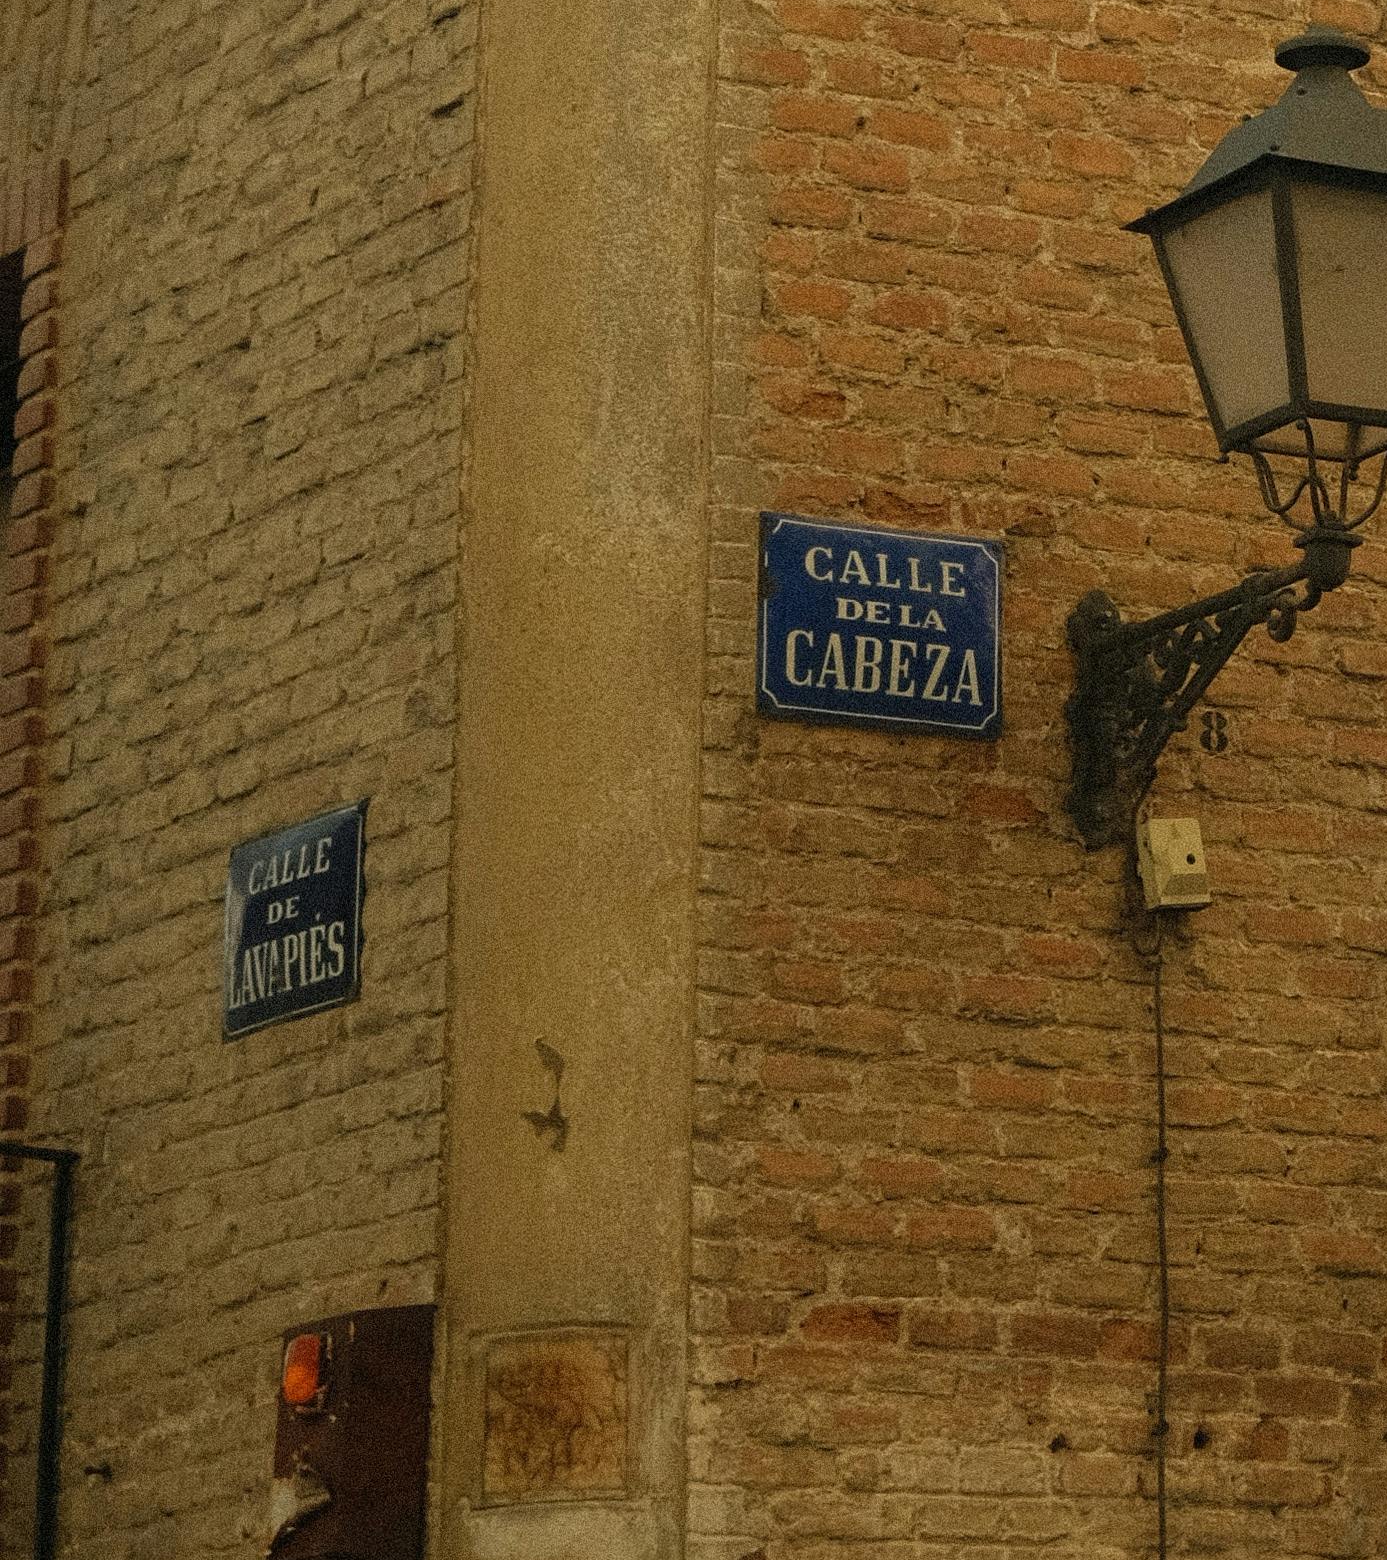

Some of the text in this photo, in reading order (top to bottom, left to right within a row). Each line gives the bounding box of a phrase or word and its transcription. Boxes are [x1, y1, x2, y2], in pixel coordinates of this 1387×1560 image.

[803, 545, 967, 598] CALLE
[835, 596, 948, 633] DE LA
[784, 630, 984, 708] CABEZA
[248, 836, 333, 896] CALLE
[266, 895, 300, 926] DE
[228, 911, 346, 1011] LAVAPIÉS
